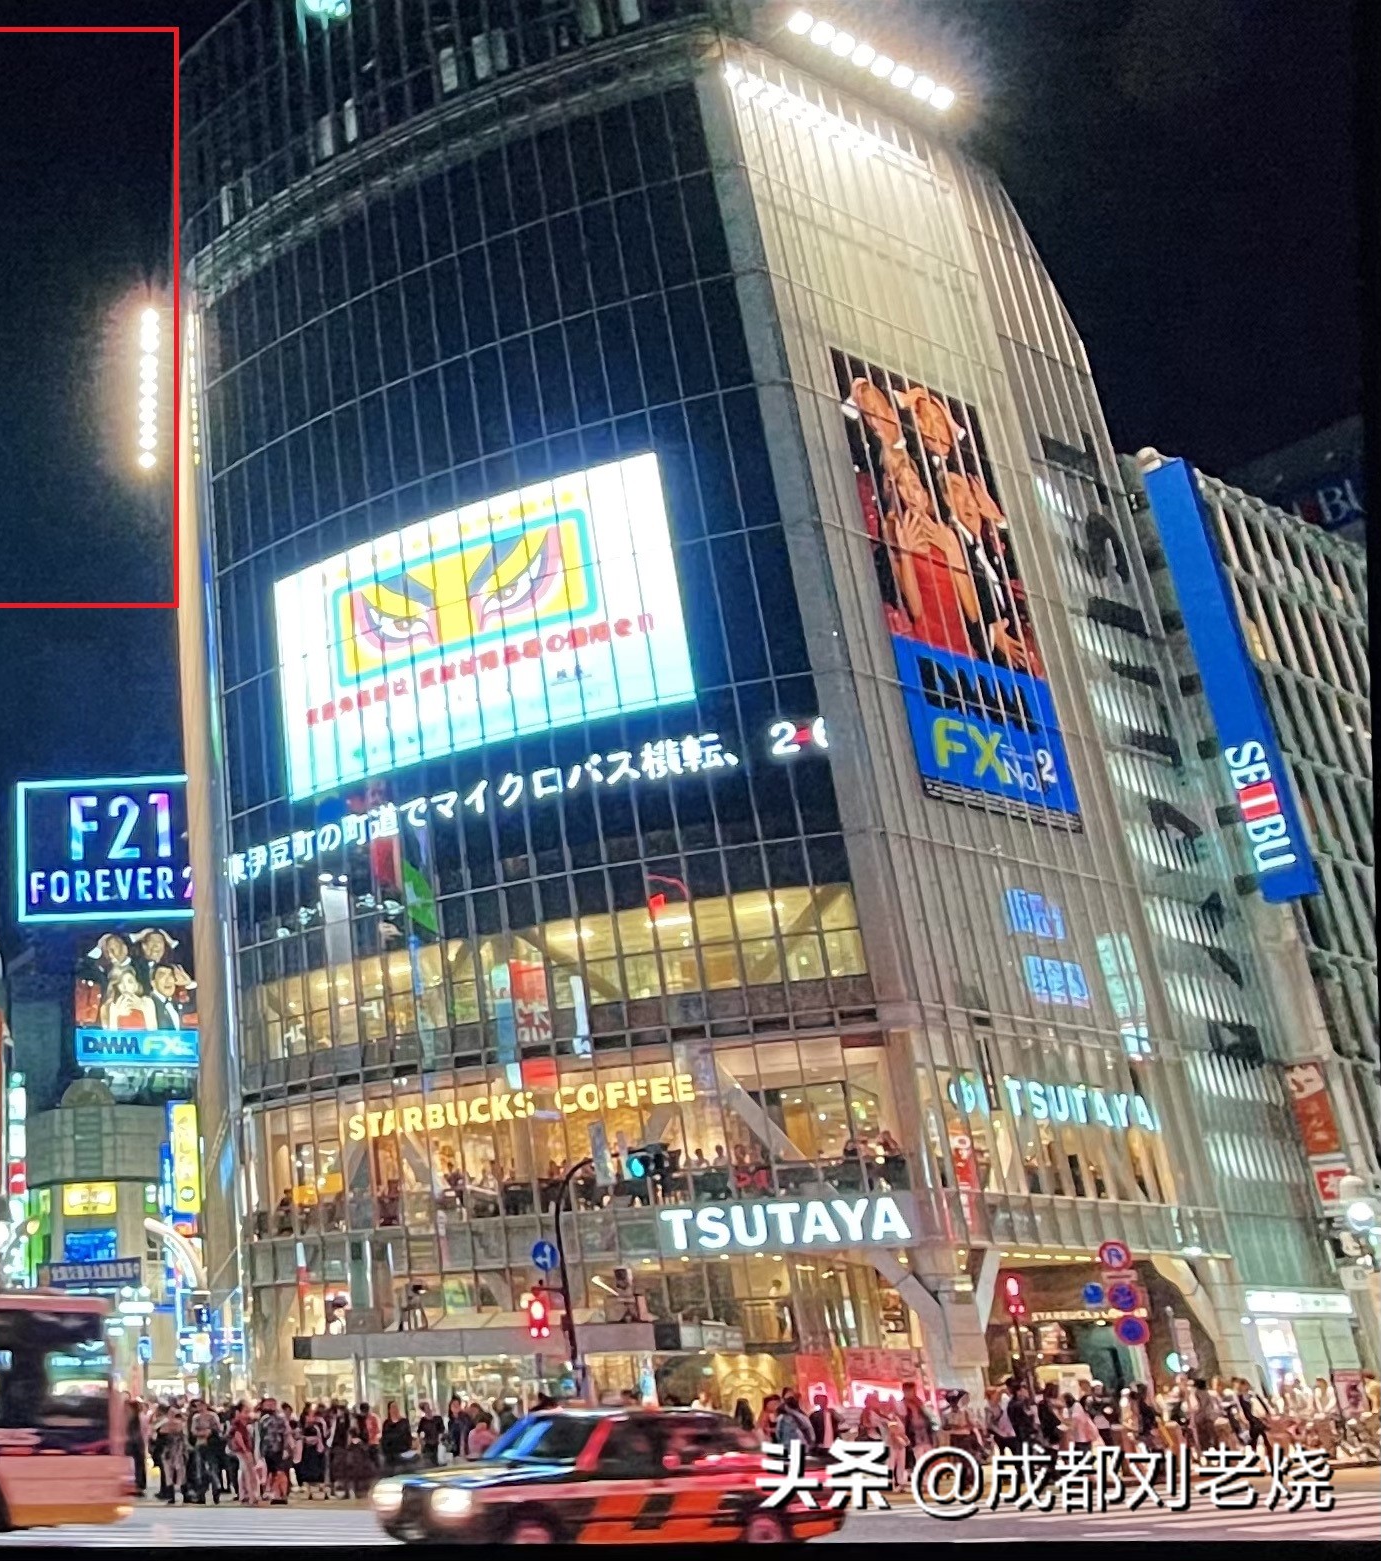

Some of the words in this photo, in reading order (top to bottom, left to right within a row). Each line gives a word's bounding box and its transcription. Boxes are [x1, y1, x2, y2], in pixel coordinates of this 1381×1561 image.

[931, 717, 1012, 785] FX
[69, 792, 172, 861] F21
[1224, 740, 1297, 872] SEIBU
[29, 866, 174, 904] FOREVER
[181, 866, 194, 900] 2
[81, 1035, 140, 1055] DMM
[142, 1035, 181, 1056] FX
[348, 1090, 536, 1142] STARBUCKS
[553, 1073, 696, 1115] COFFEE
[1004, 1076, 1157, 1131] TSUTAYA
[660, 1197, 912, 1251] TSUTAYA
